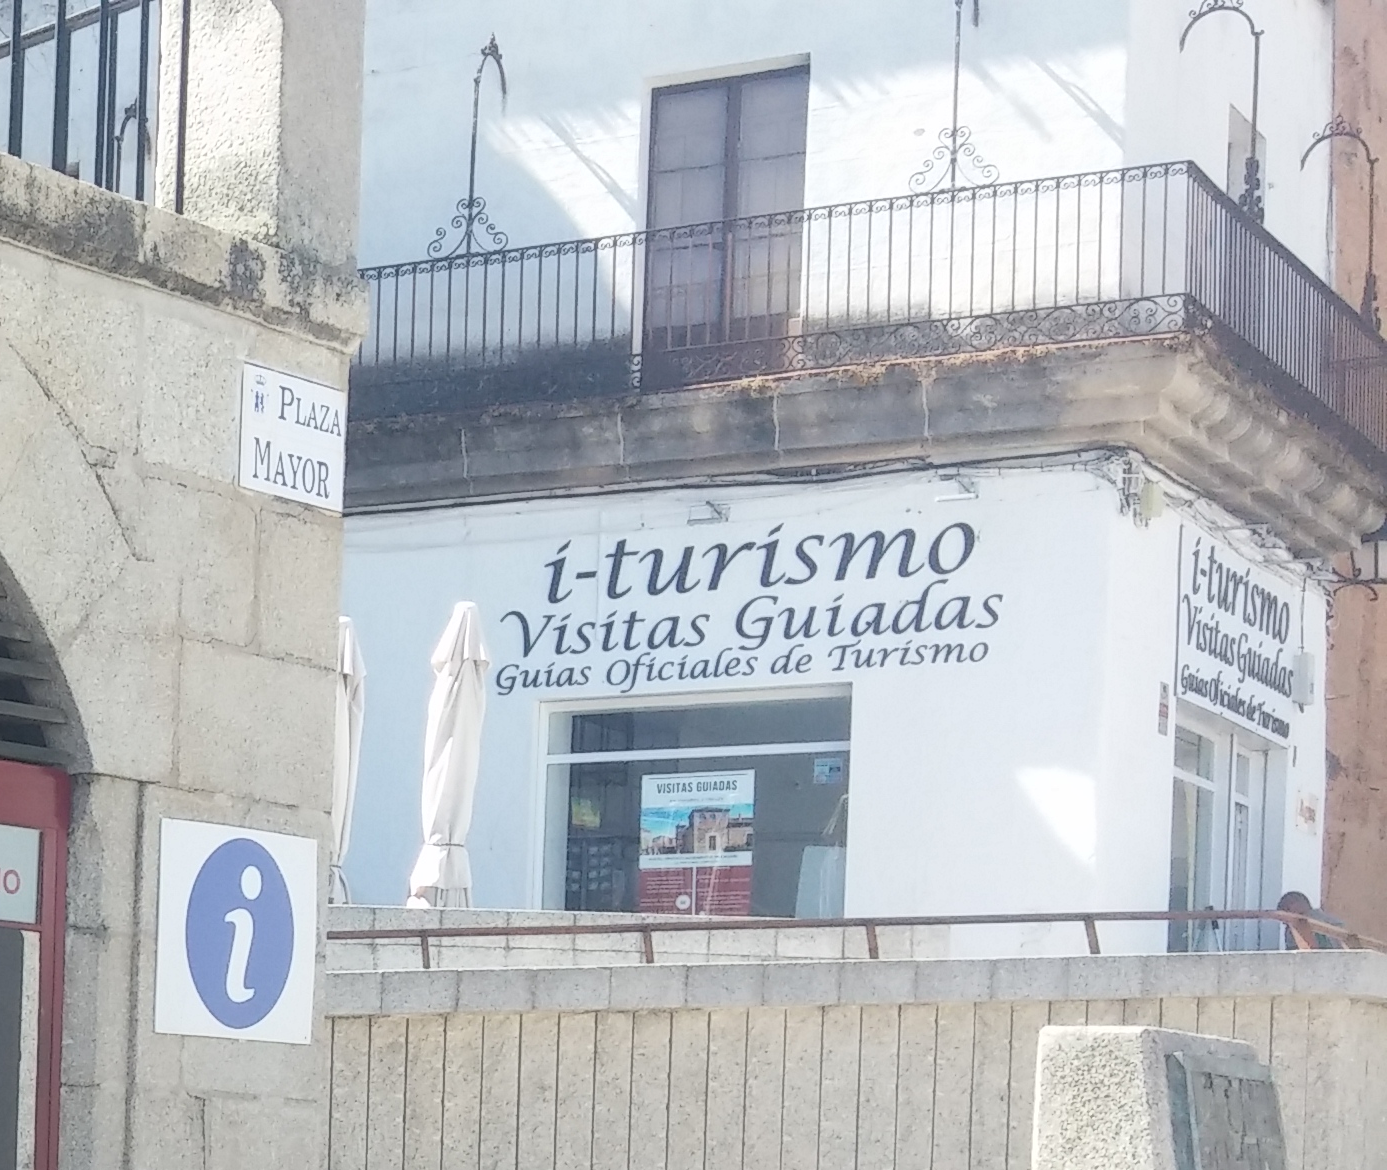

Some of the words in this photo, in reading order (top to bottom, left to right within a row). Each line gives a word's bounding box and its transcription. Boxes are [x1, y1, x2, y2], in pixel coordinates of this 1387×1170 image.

[278, 385, 342, 437] PLAZA
[252, 437, 331, 499] MAYOR
[545, 521, 978, 605] i-turismo
[1191, 537, 1291, 645] i-turismo
[499, 602, 711, 659] Visitas
[732, 586, 1005, 651] Guiadas
[1182, 594, 1237, 666] Visitas
[1237, 633, 1294, 699] Guiadas
[604, 646, 756, 689] Oficiales
[770, 642, 813, 675] de
[829, 635, 990, 672] Turismo
[1209, 670, 1246, 717] Oficiales
[1246, 694, 1257, 722] de
[1256, 700, 1290, 739] Turismo
[656, 781, 694, 795] VISITAS
[696, 779, 738, 793] GUIADAS
